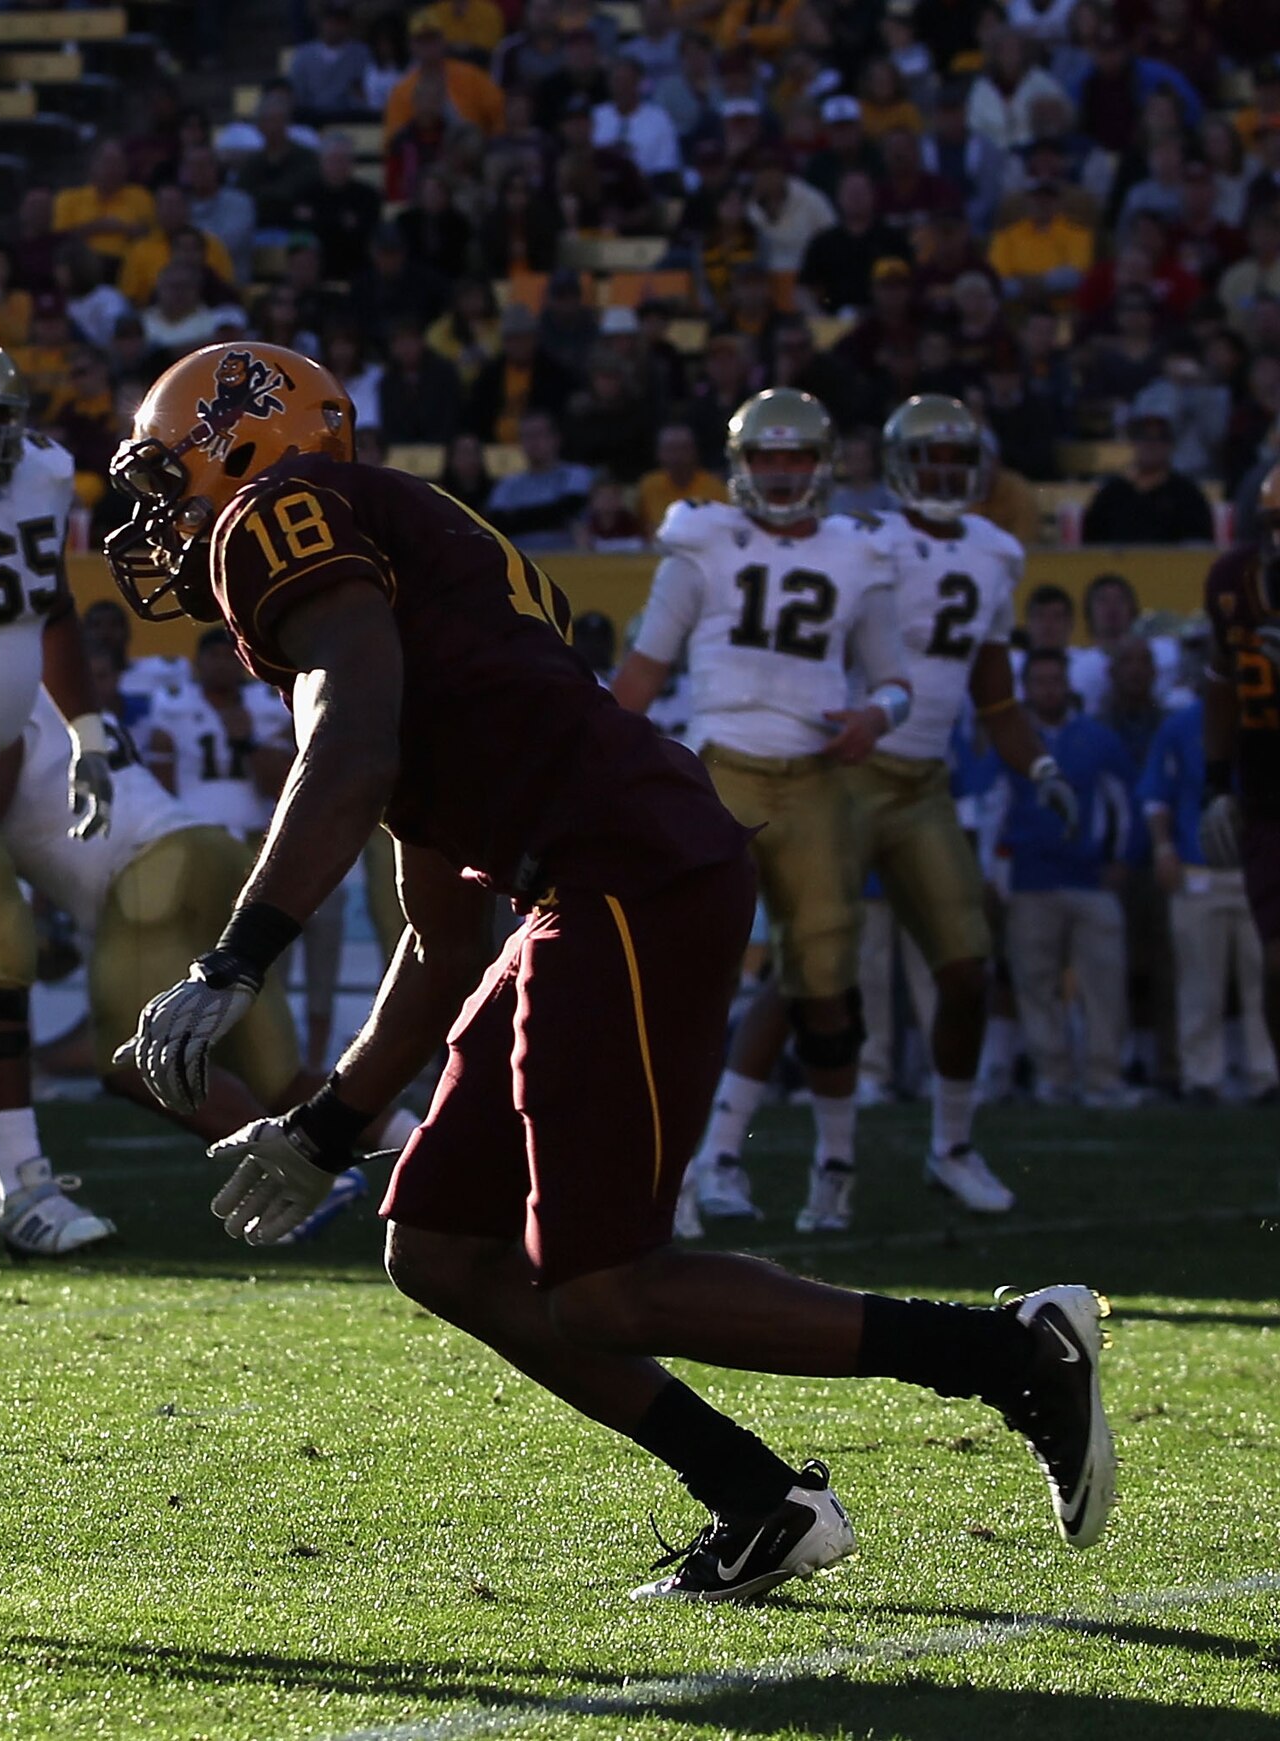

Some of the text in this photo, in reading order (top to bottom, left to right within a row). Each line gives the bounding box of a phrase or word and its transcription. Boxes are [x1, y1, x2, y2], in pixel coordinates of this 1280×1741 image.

[244, 491, 336, 578] 18
[729, 564, 837, 661] 12
[926, 572, 979, 659] 2
